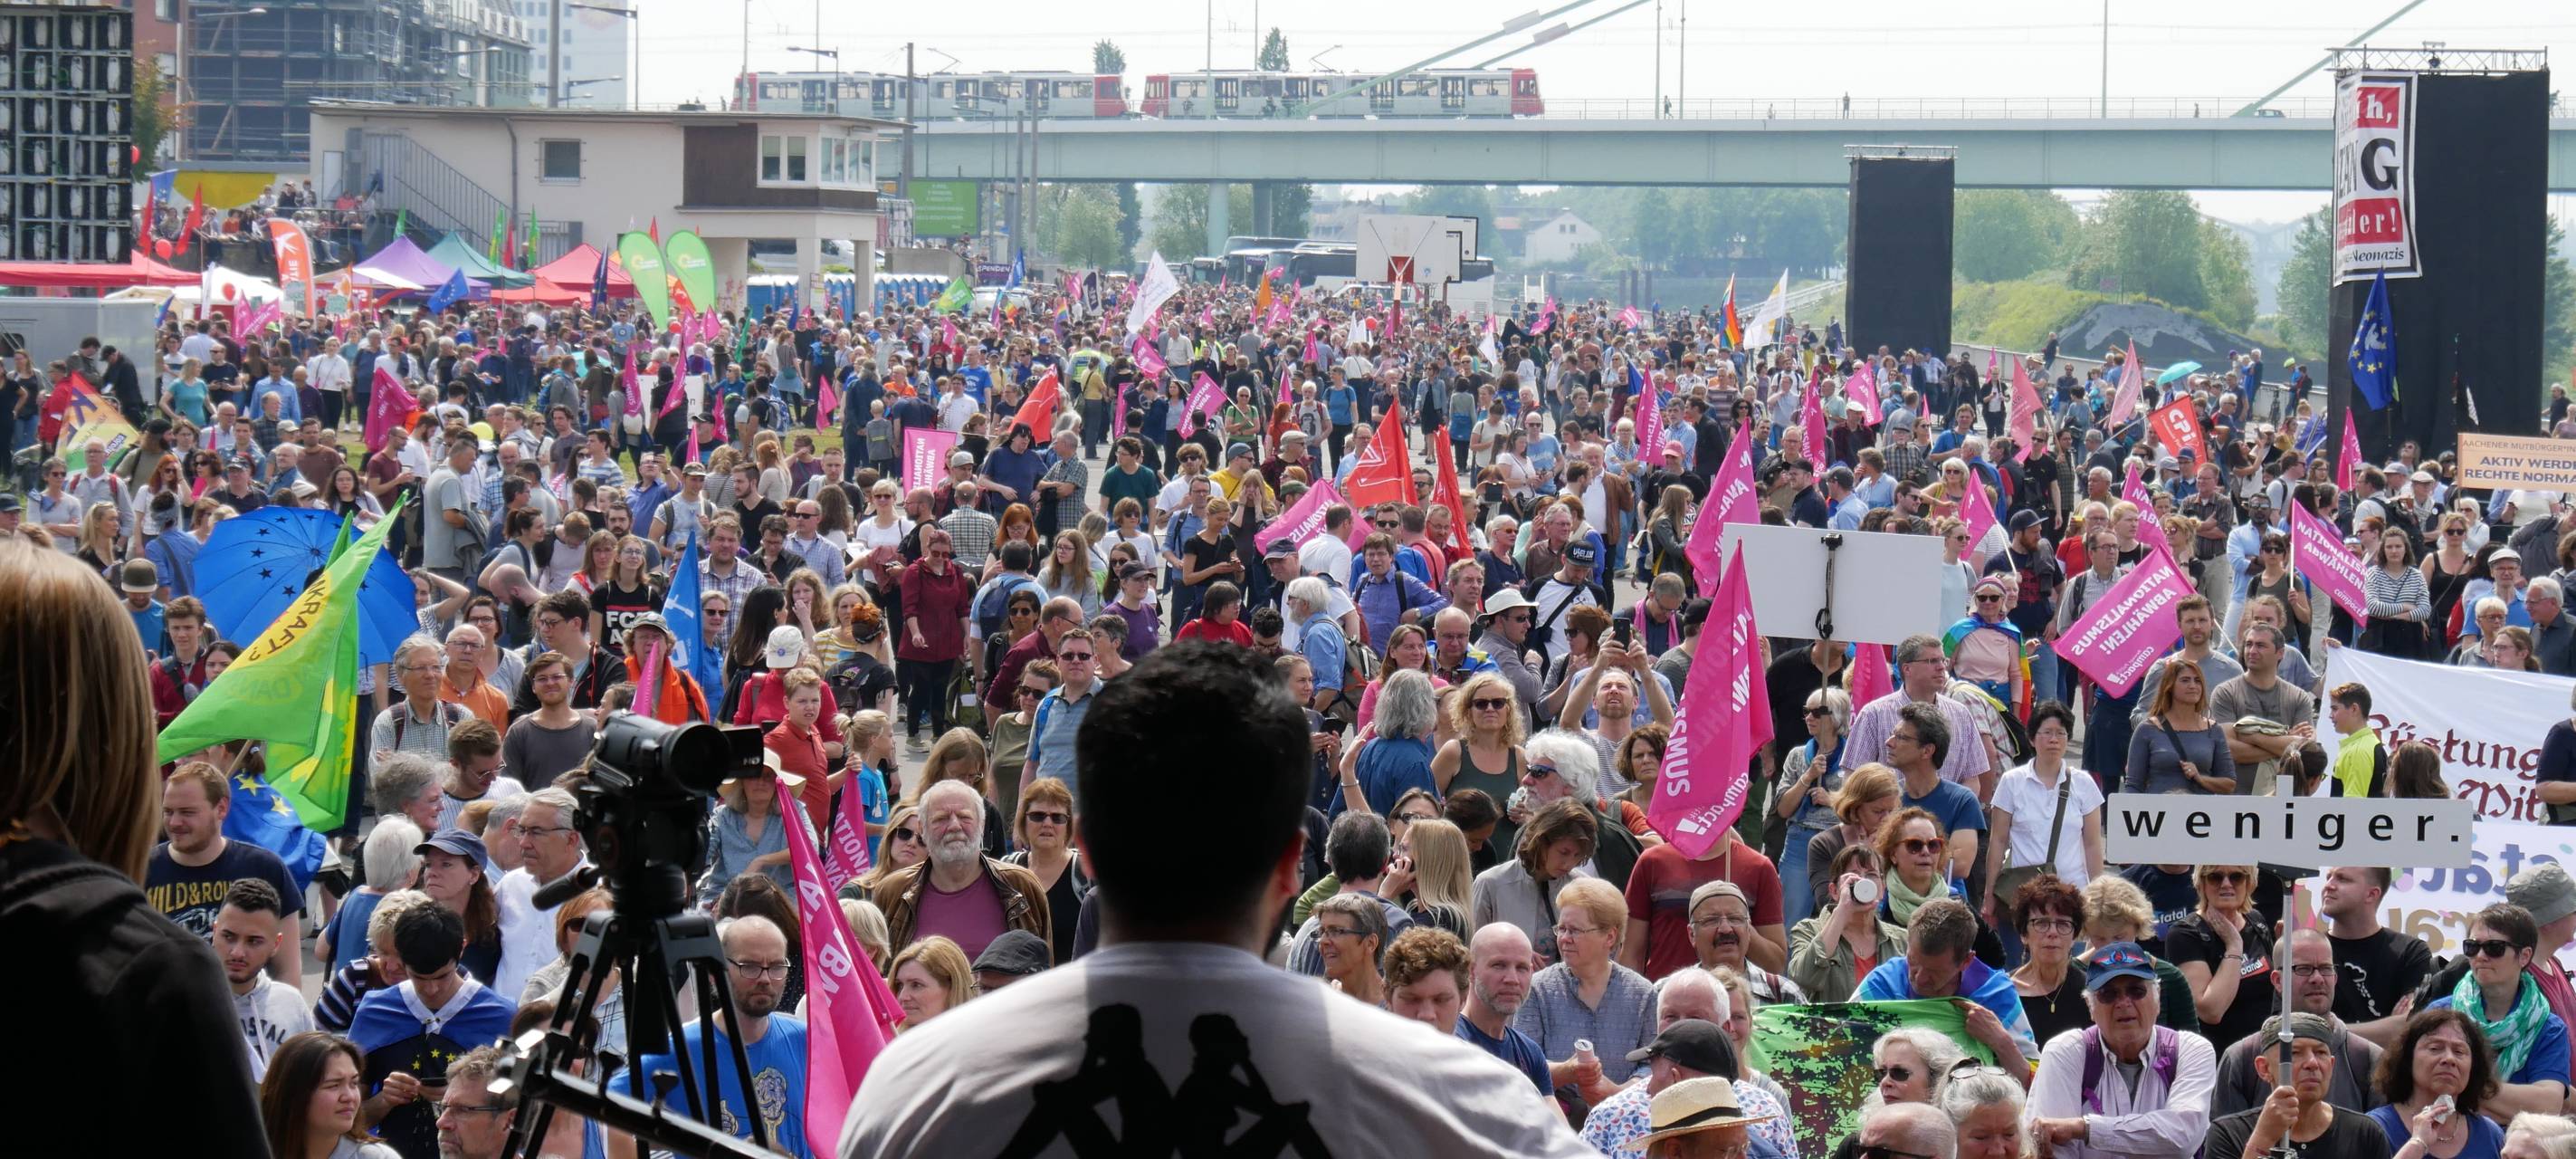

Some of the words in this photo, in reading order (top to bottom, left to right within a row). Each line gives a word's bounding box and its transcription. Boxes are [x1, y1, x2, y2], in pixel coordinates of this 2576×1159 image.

[2463, 439, 2509, 450] AACHENER
[2480, 455, 2524, 467] AKTIV
[2465, 468, 2520, 481] RECHTE
[2122, 802, 2460, 851] weniger.
